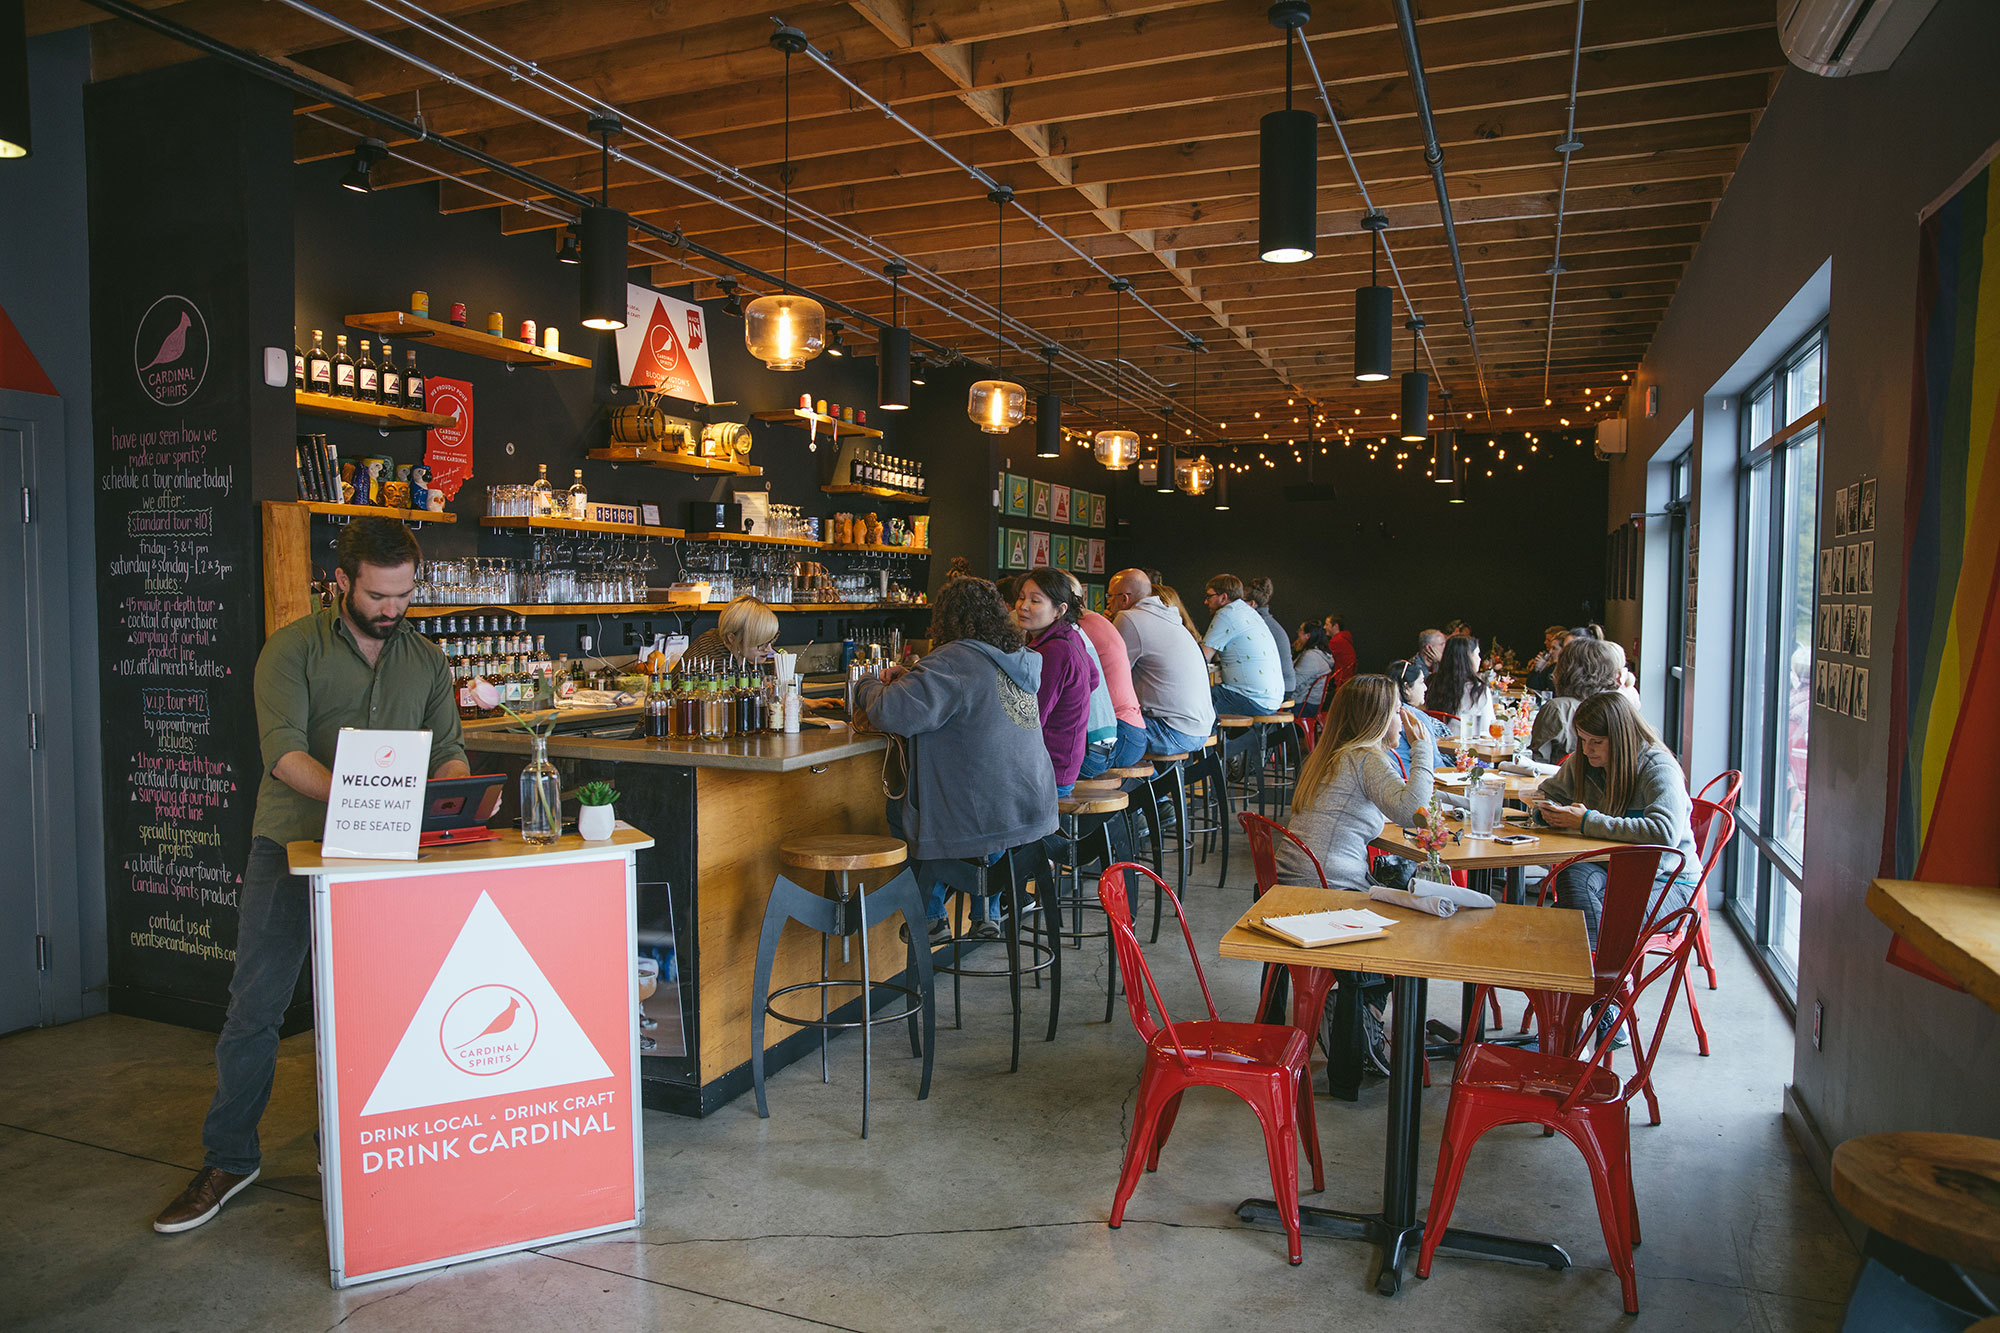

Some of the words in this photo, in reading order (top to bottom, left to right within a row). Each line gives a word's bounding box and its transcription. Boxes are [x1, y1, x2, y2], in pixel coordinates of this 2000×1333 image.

[689, 322, 701, 338] IN
[148, 368, 195, 386] CARDINAL
[155, 384, 187, 400] SPIRITS
[112, 426, 137, 451] have
[139, 431, 157, 457] you
[159, 428, 180, 445] seen
[182, 419, 201, 443] how
[203, 427, 218, 442] we
[439, 428, 461, 437] CARDINAL
[442, 434, 459, 442] SPIRITS
[129, 452, 154, 468] make
[155, 450, 171, 465] our
[172, 444, 207, 472] spirits?
[446, 456, 467, 464] CARDINAL
[102, 466, 140, 490] schedule
[141, 474, 149, 487] a
[152, 468, 174, 489] tour
[173, 468, 201, 489] online
[204, 465, 233, 497] today!
[143, 497, 155, 509] we
[131, 513, 171, 532] standard
[173, 513, 193, 531] tour
[194, 512, 208, 530] $10
[597, 507, 634, 523] 15169
[173, 541, 178, 554] 3
[181, 541, 187, 553] &
[188, 540, 194, 556] 4
[195, 545, 209, 560] pm
[110, 554, 150, 577] saturday
[126, 596, 137, 612] 45
[137, 596, 162, 612] minute
[163, 596, 196, 616] in-depth
[198, 596, 215, 612] tour
[127, 612, 160, 629] cocktail
[161, 613, 170, 629] of
[170, 616, 191, 635] your
[191, 612, 218, 630] choice
[133, 630, 168, 648] sampling
[170, 630, 179, 644] of
[181, 633, 196, 645] our
[196, 630, 209, 646] full
[147, 645, 178, 662] product
[180, 645, 195, 661] line
[137, 658, 148, 675] off
[148, 658, 160, 676] all
[161, 660, 187, 676] merch
[195, 659, 224, 678] bottles
[167, 689, 187, 711] tour
[188, 694, 205, 712] $42
[144, 716, 154, 737] by
[156, 717, 210, 738] appointment
[166, 754, 205, 777] in-depth
[205, 756, 226, 775] tour
[134, 769, 168, 786] cocktail
[170, 769, 179, 788] of
[180, 773, 200, 794] your
[202, 774, 230, 794] choice
[342, 774, 417, 788] WELCOME!
[138, 787, 177, 808] sampling
[189, 793, 205, 806] our
[205, 790, 219, 807] full
[341, 799, 381, 809] PLEASE
[384, 799, 411, 810] WAIT
[155, 804, 186, 821] product
[188, 804, 204, 821] line
[139, 821, 178, 845] specialty
[180, 824, 221, 846] research
[336, 820, 351, 830] TO
[353, 820, 366, 831] BE
[369, 821, 412, 832] SEATED
[159, 842, 194, 861] projects
[132, 860, 139, 872] a
[140, 853, 164, 875] bottle
[165, 859, 175, 875] of
[175, 866, 197, 884] your
[197, 861, 232, 884] favorite
[132, 874, 169, 895] Cardinal
[171, 878, 200, 901] Spirits
[201, 886, 238, 908] product
[149, 910, 184, 933] contact
[187, 920, 198, 936] us
[199, 919, 211, 939] at
[460, 1043, 520, 1059] CARDINAL
[468, 1054, 512, 1068] SPIRITS
[360, 1123, 420, 1145] DRINK
[424, 1113, 483, 1135] LOCAL
[504, 1101, 559, 1122] DRINK
[563, 1091, 615, 1112] CRAFT
[362, 1137, 461, 1174] DRINK
[468, 1111, 616, 1156] CARDINAL
